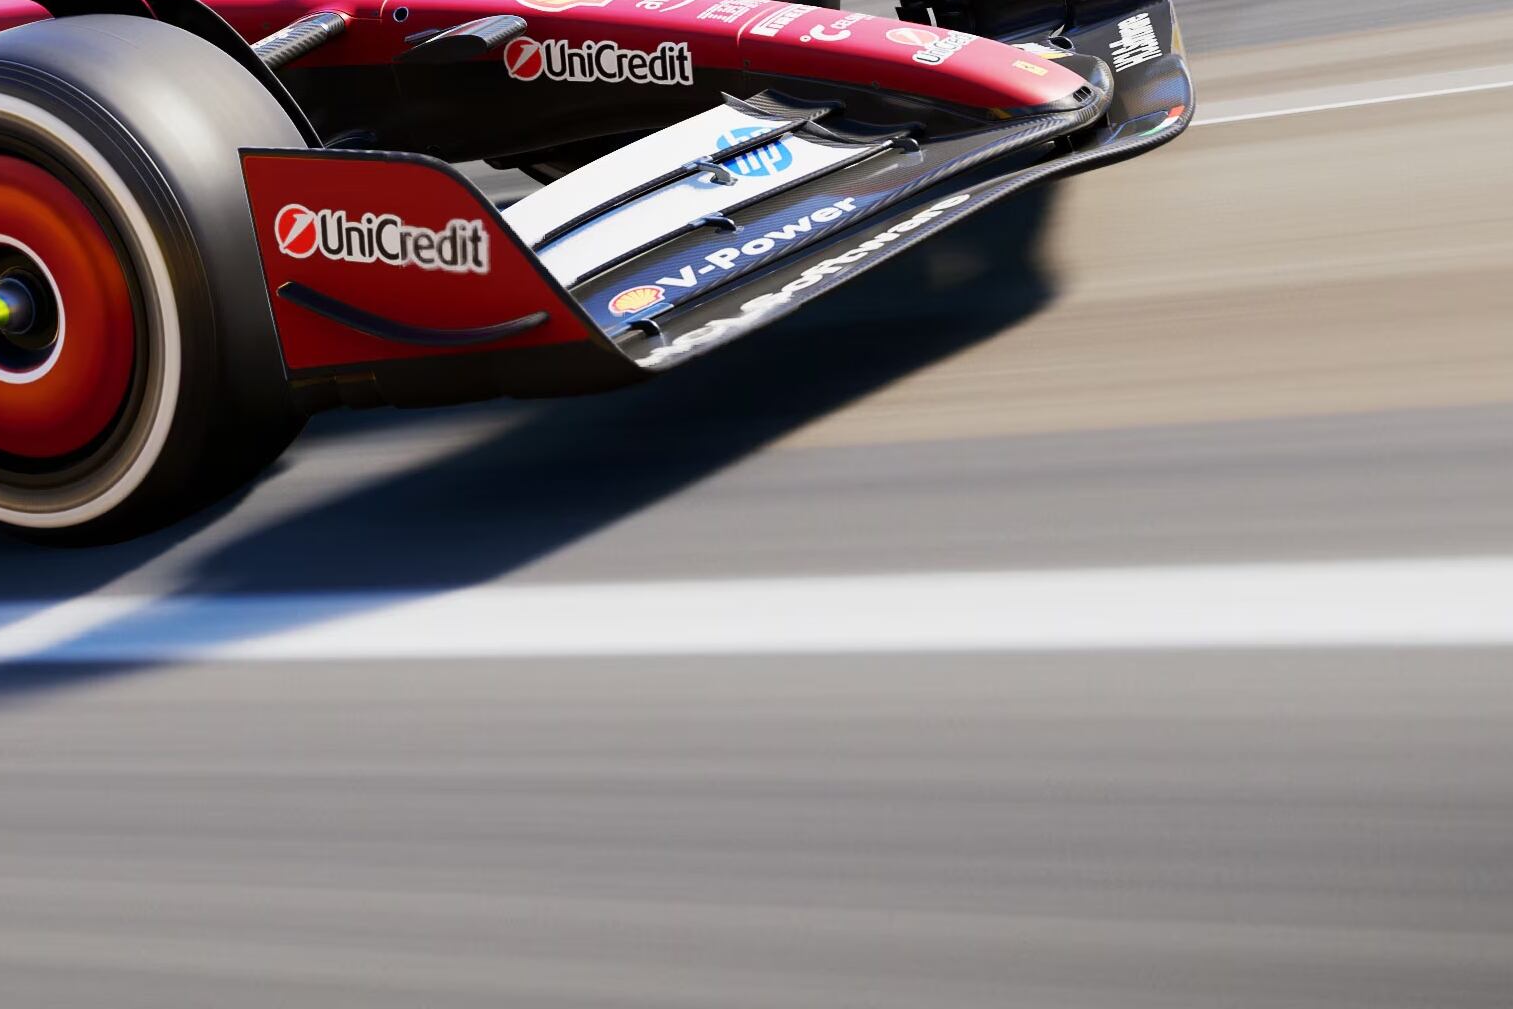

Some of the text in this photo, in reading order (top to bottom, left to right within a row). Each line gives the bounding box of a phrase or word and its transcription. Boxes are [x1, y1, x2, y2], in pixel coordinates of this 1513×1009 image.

[544, 42, 690, 82] UniCredit
[320, 213, 484, 269] UniCredit
[655, 197, 857, 288] V-Power
